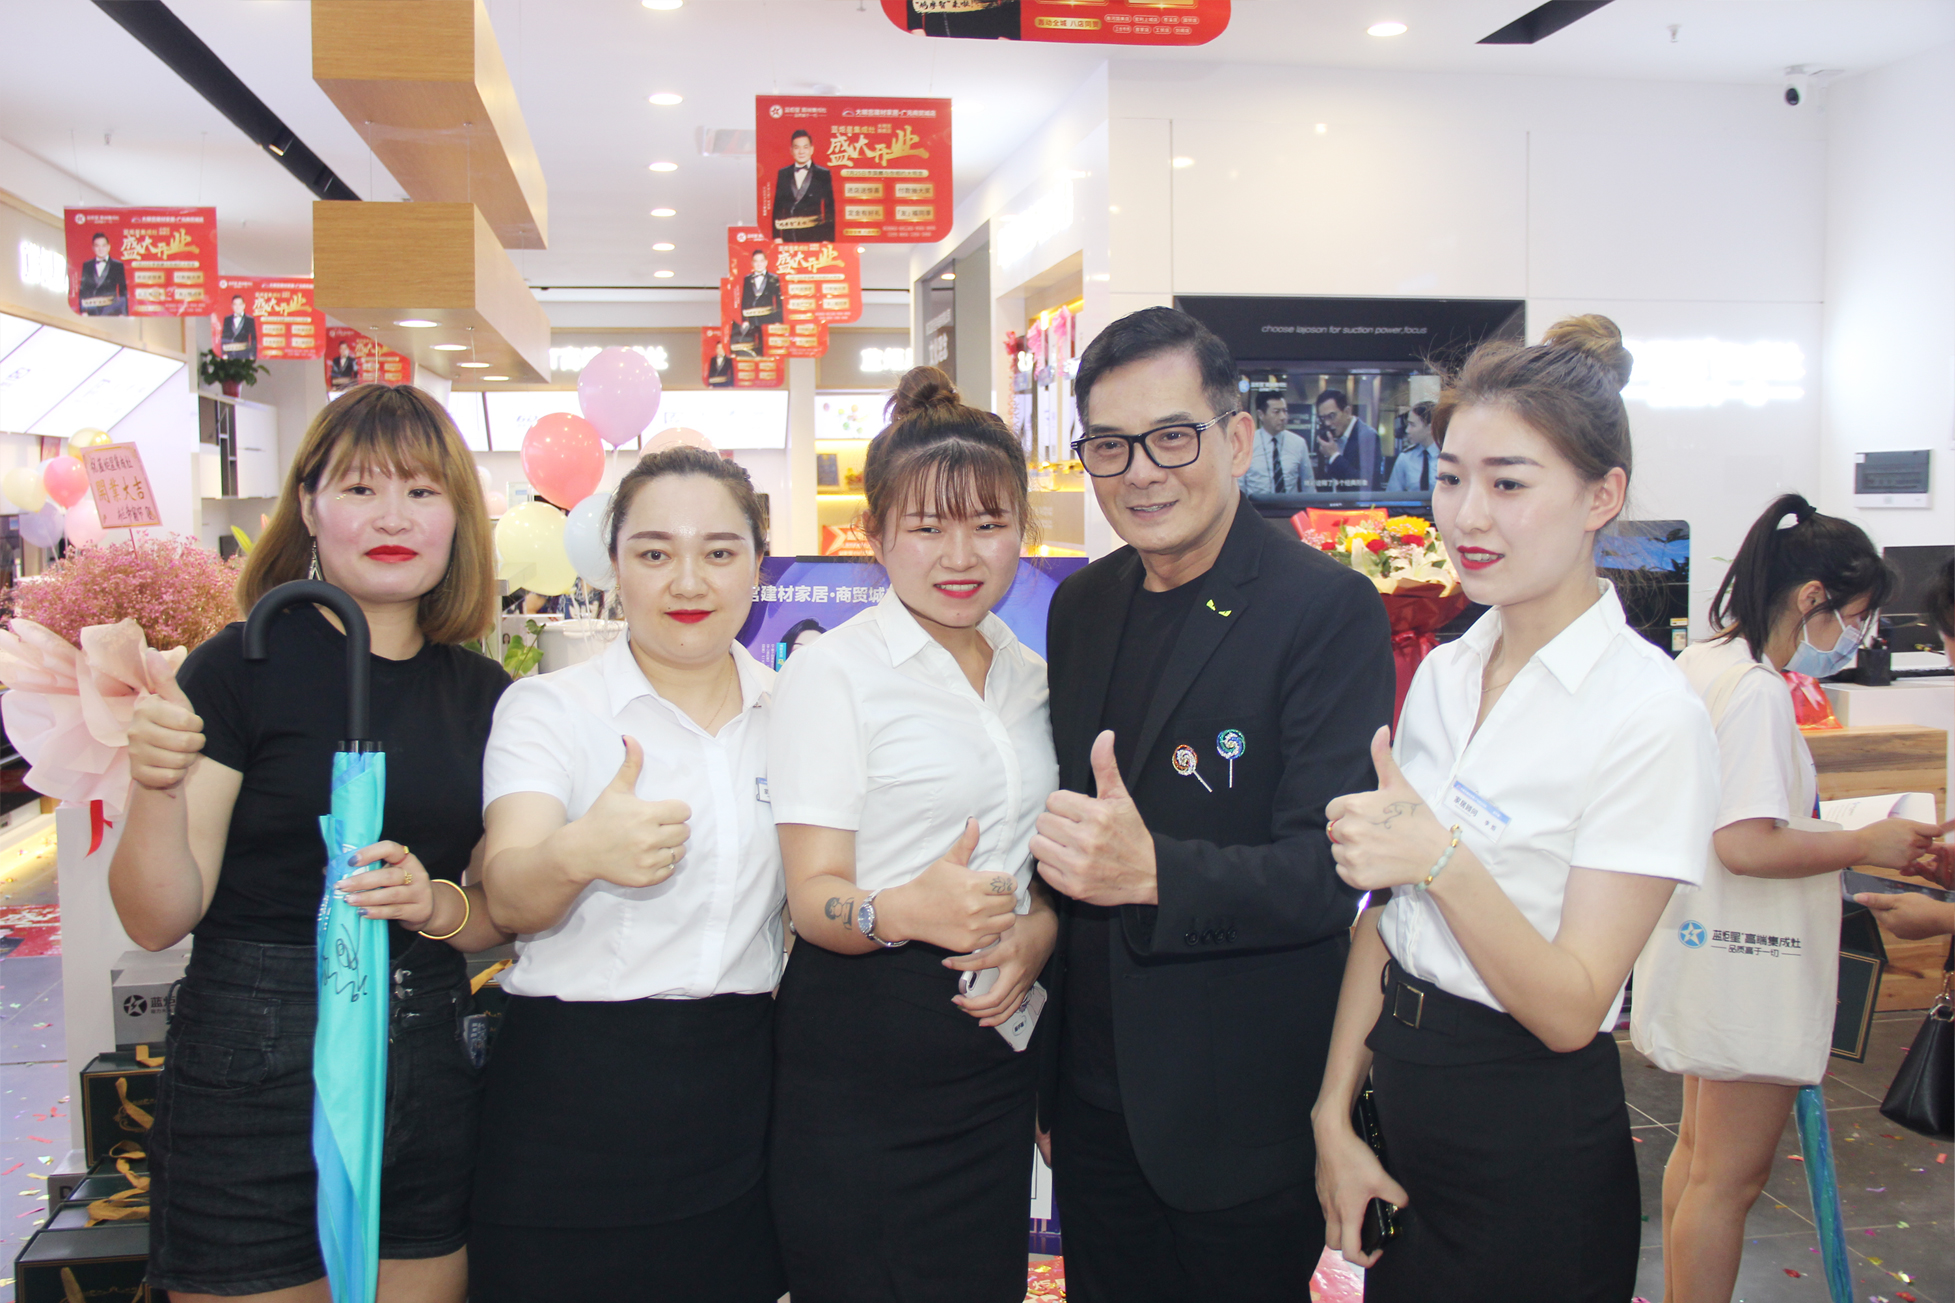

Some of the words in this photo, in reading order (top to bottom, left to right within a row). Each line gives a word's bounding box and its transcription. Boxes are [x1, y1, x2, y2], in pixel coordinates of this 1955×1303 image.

[826, 125, 930, 167] 盛大开业
[121, 228, 200, 260] 盛大开业
[776, 244, 846, 274] 盛大开业
[252, 292, 312, 317] 盛大开业
[1261, 325, 1295, 333] choose
[1328, 325, 1341, 333] for
[1342, 325, 1374, 334] suction
